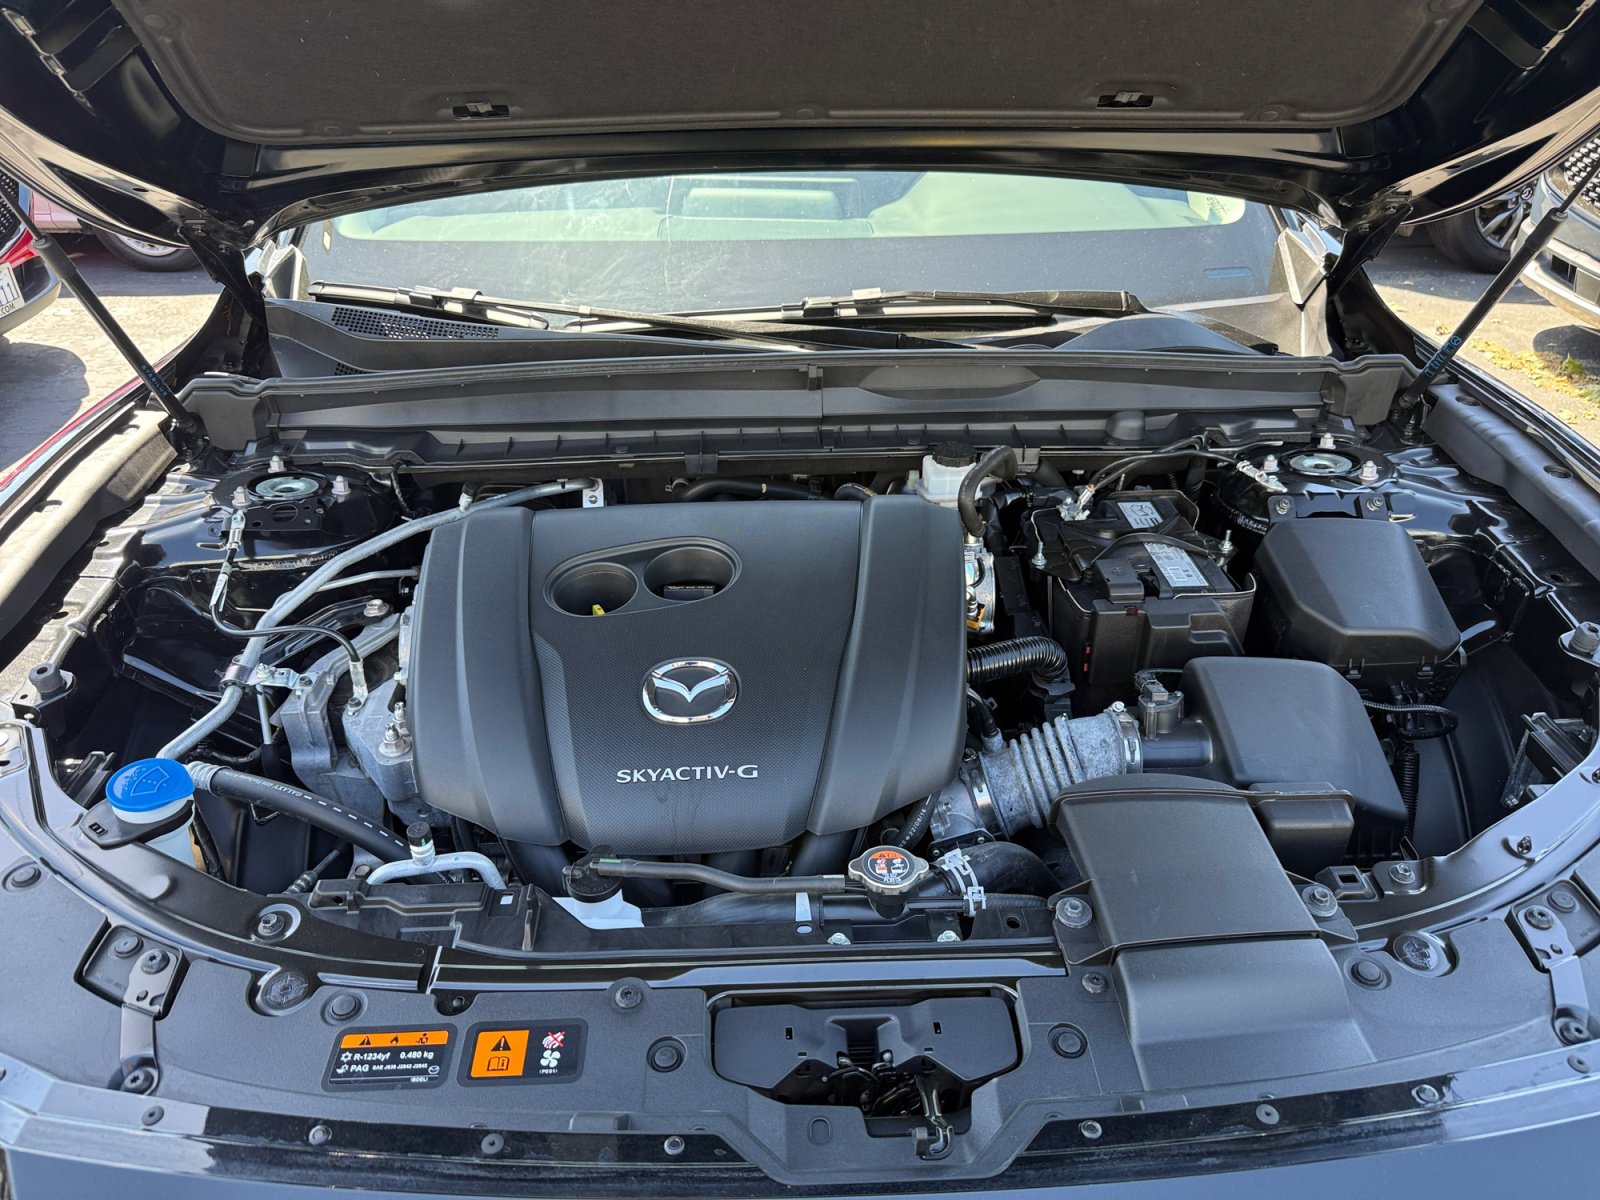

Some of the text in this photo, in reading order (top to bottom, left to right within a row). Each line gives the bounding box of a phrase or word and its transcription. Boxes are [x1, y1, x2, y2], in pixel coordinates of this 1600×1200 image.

[616, 764, 759, 784] SKYACTIV-G
[353, 1050, 434, 1061] R-1234yf 0.480 kg
[350, 1064, 370, 1072] PAG
